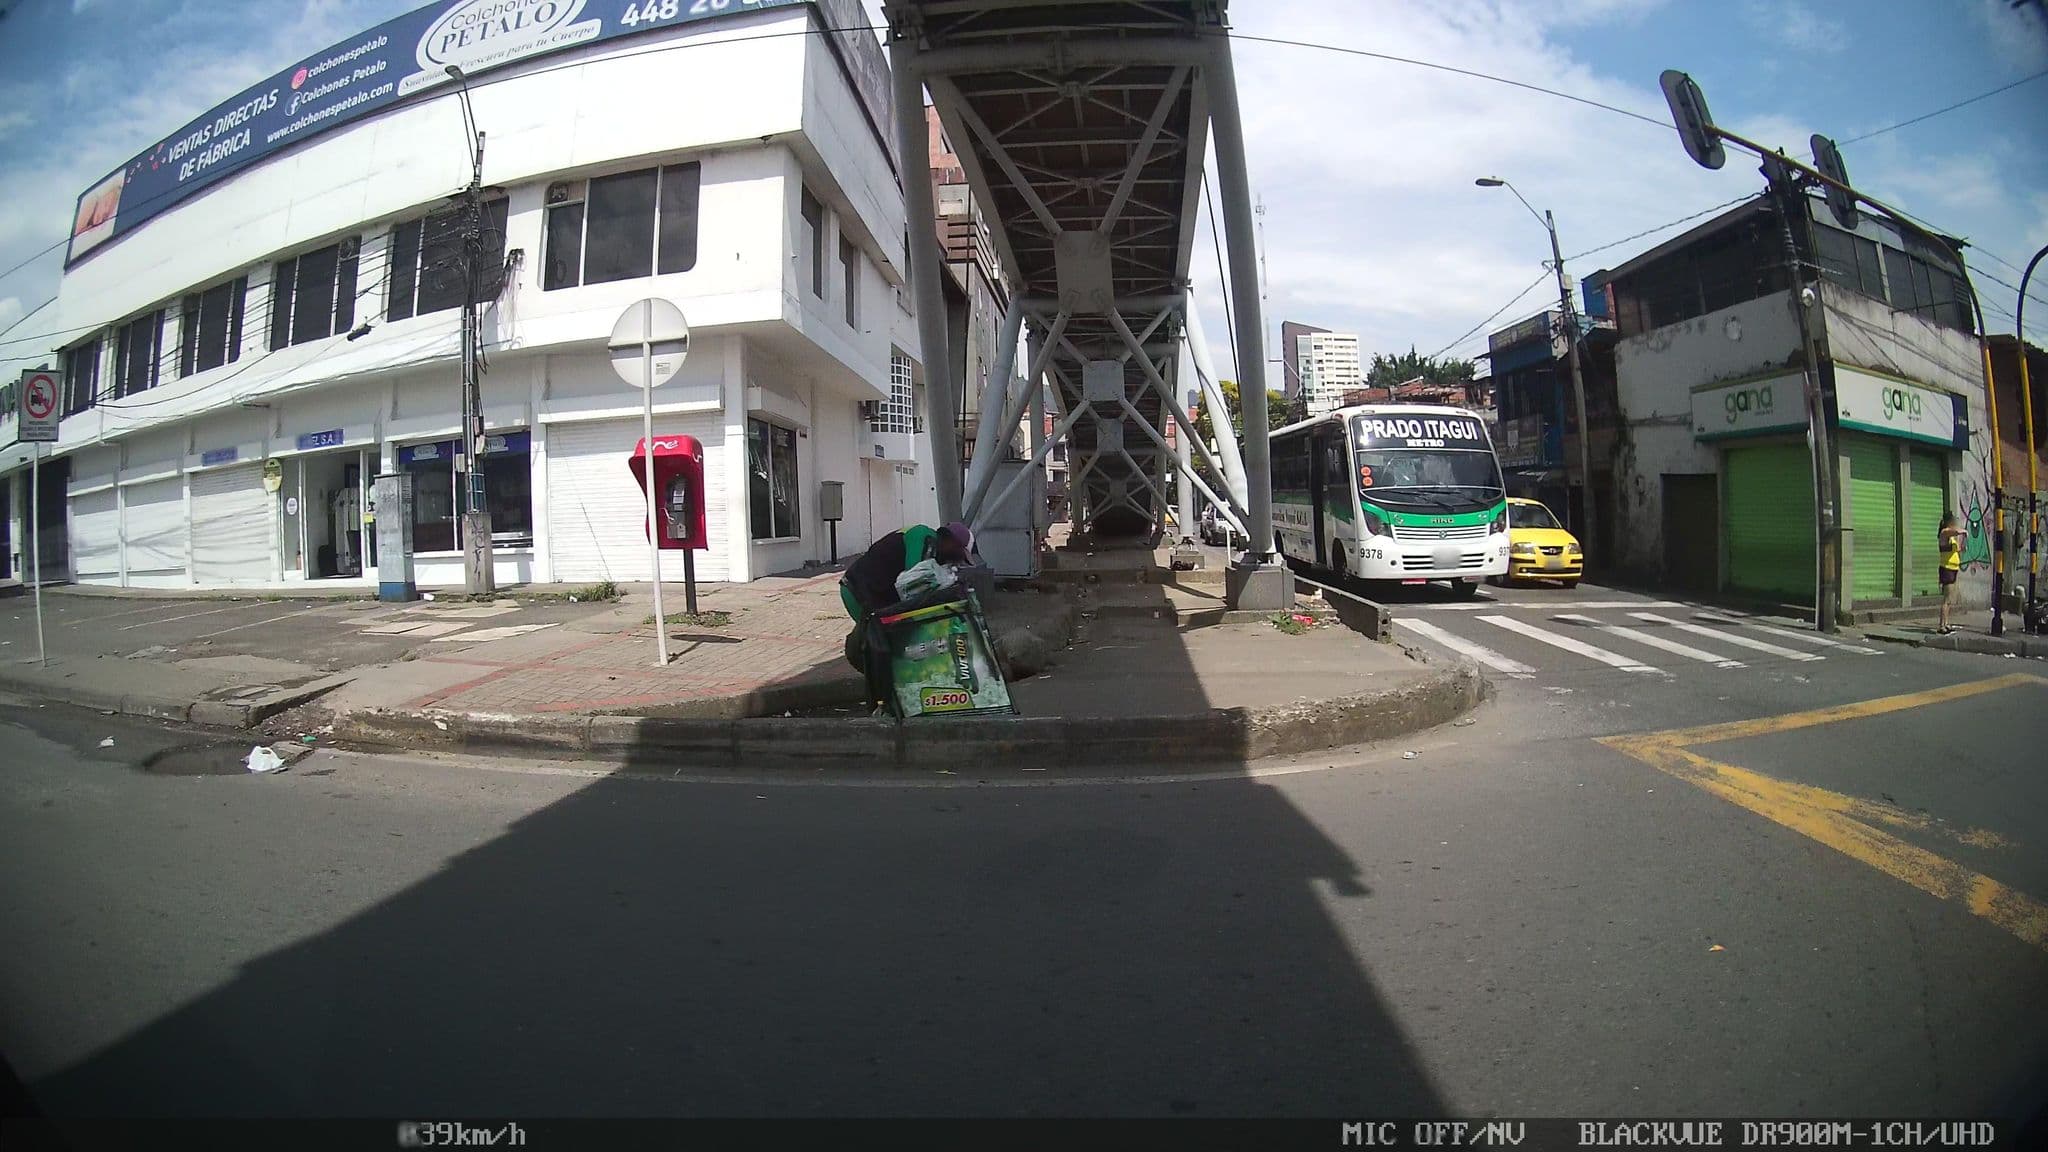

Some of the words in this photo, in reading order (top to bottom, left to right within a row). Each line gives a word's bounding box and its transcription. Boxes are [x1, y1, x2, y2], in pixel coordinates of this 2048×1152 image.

[441, 2, 557, 54] PETALO
[620, 0, 679, 27] 448
[307, 36, 388, 79] colchonespetalo
[301, 75, 351, 104] Colchones
[352, 60, 387, 83] Petalo
[168, 124, 213, 163] VENTAS
[213, 88, 279, 138] DIRECTAS
[266, 82, 394, 143] www.colchonespetalo.com
[179, 157, 196, 181] DE
[196, 128, 251, 172] FÁBRICA
[1725, 385, 1774, 424] gana
[1882, 386, 1921, 421] gana
[1360, 419, 1423, 439] PRADO
[1424, 420, 1479, 441] ITAGUI
[1406, 439, 1445, 447] METRO
[1360, 548, 1383, 560] 9378
[924, 693, 969, 706] $1.500
